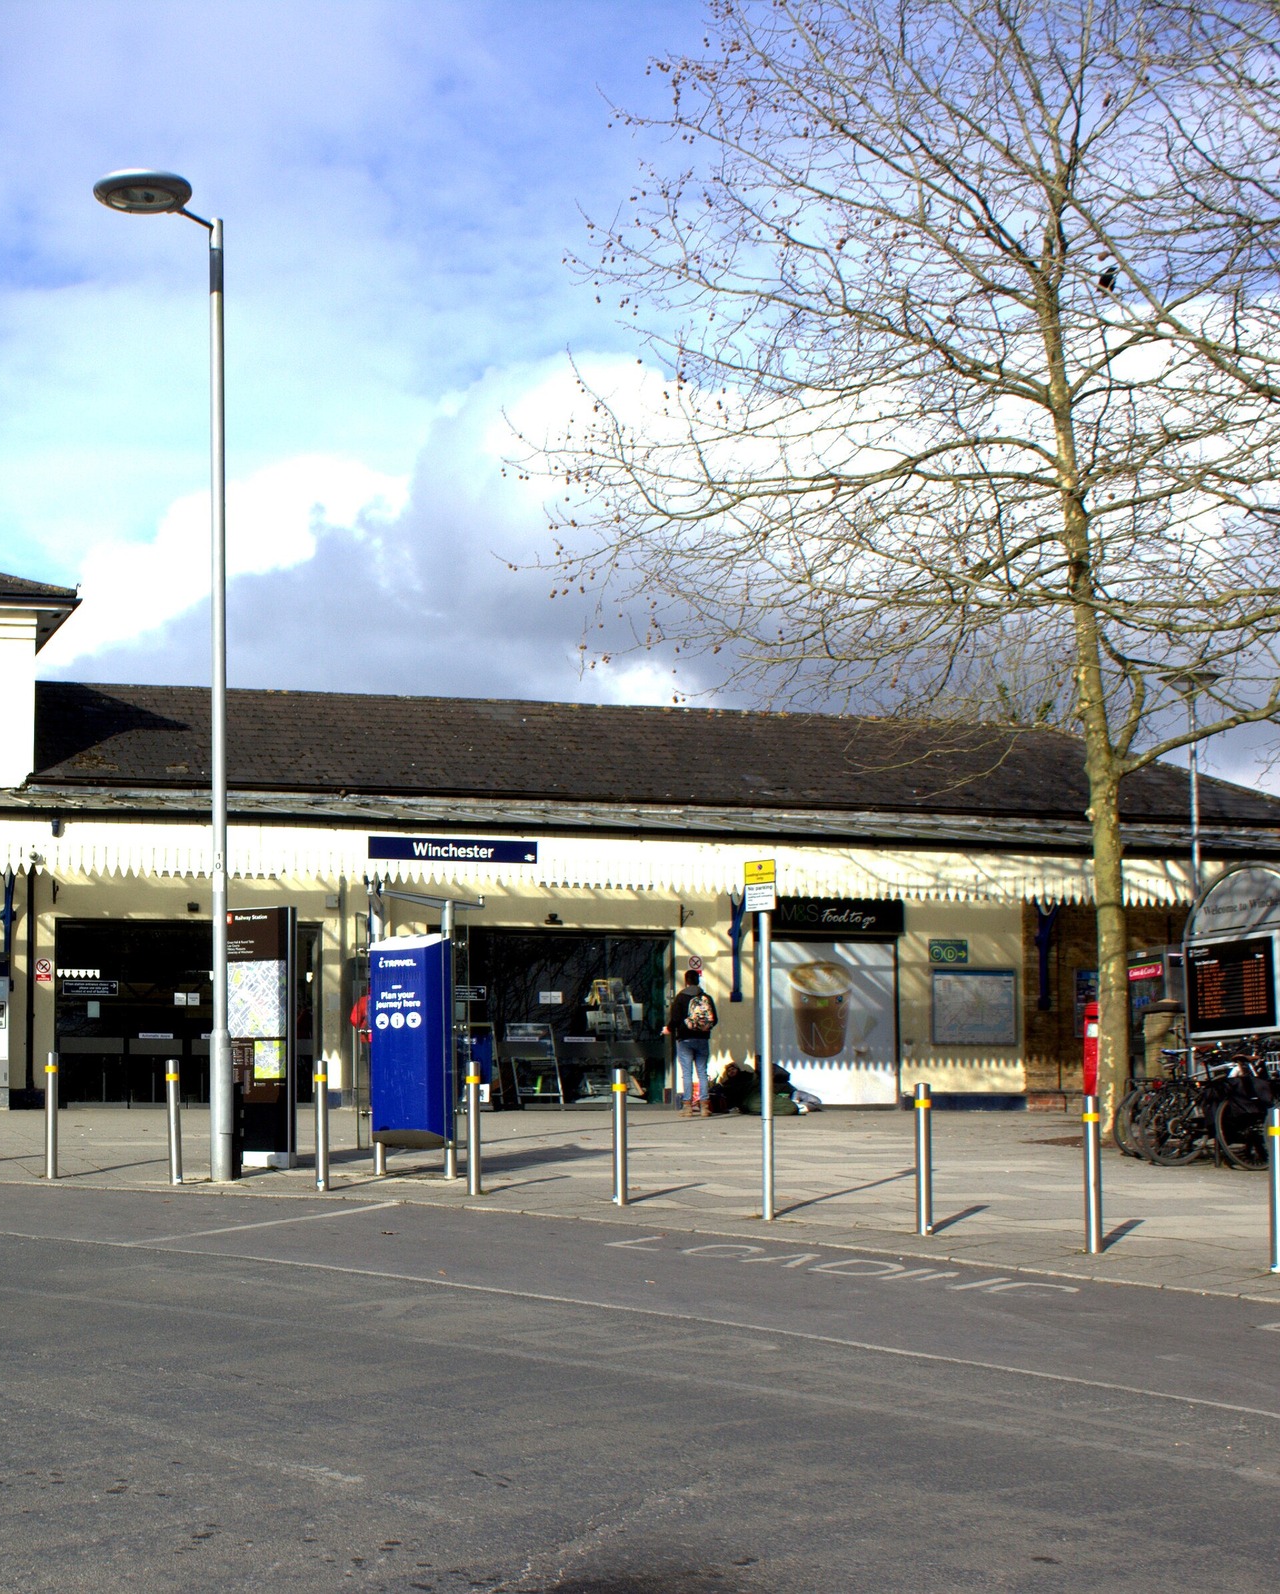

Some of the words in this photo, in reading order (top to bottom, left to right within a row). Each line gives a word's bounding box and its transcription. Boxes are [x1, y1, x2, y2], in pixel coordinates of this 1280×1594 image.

[413, 842, 494, 859] Winchester
[1203, 904, 1237, 915] Welcome
[781, 903, 819, 922] M&S
[820, 907, 850, 923] Food
[849, 911, 863, 923] to
[861, 915, 876, 929] go
[948, 949, 955, 958] D
[380, 991, 397, 1000] Plan
[397, 991, 416, 1001] your
[375, 1000, 403, 1011] journey
[402, 999, 422, 1008] here
[604, 1235, 1080, 1295] LOADING
